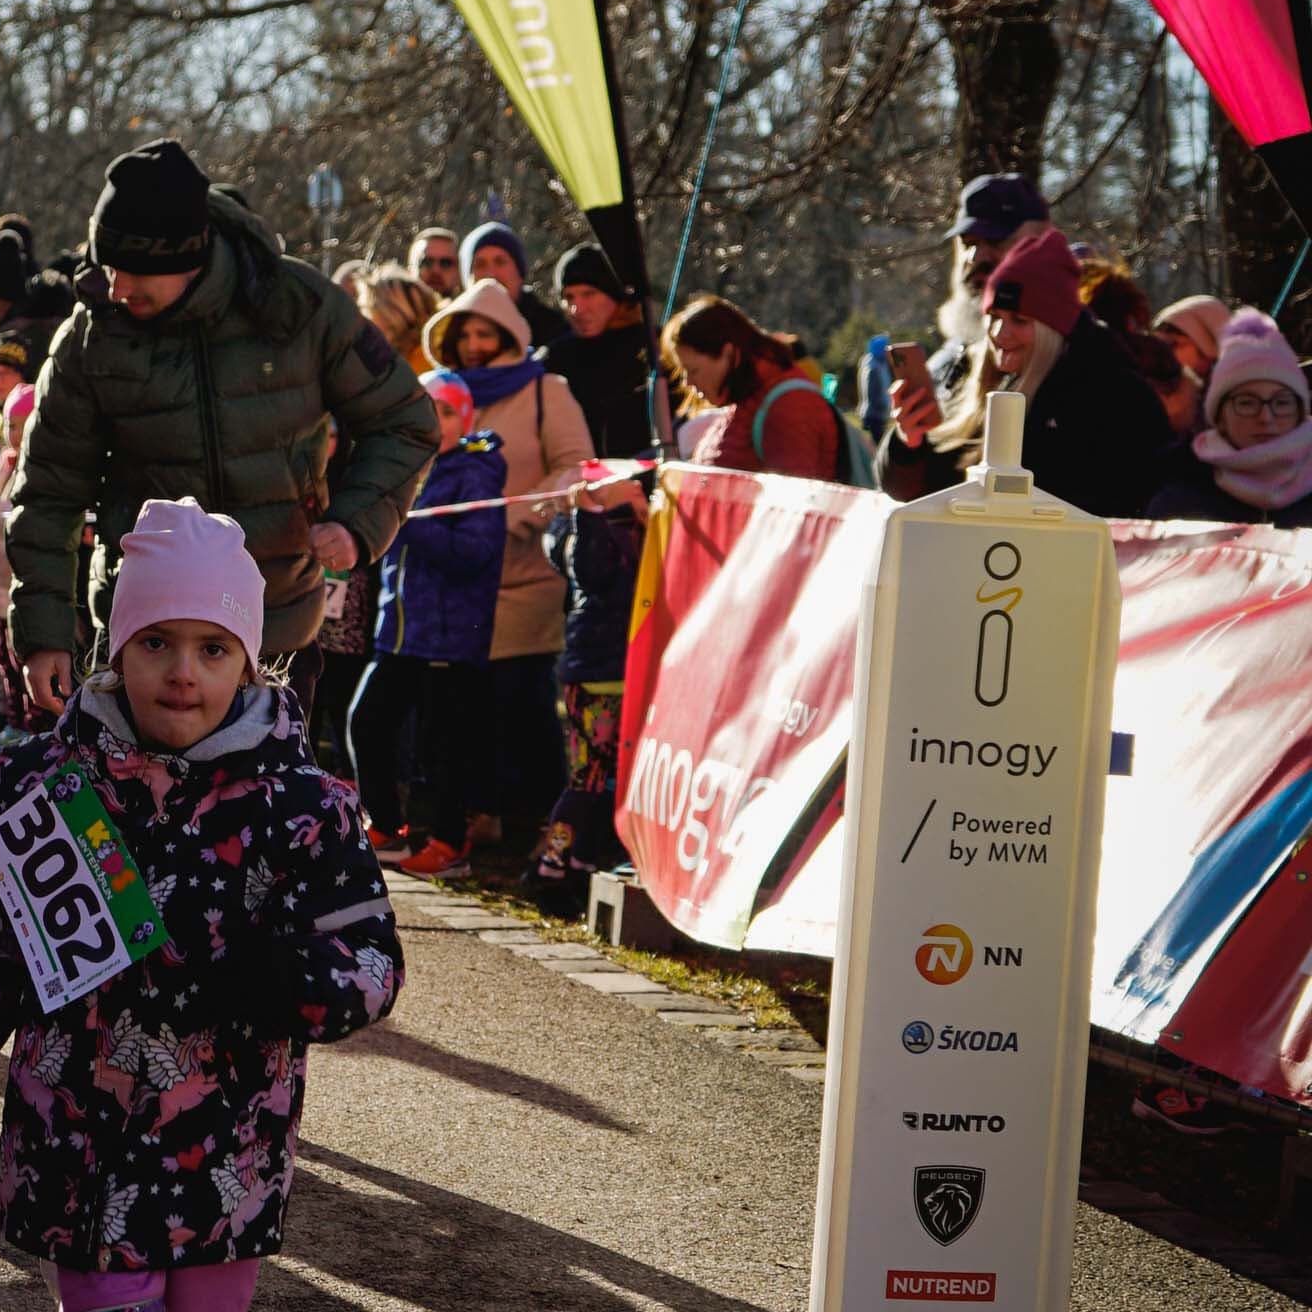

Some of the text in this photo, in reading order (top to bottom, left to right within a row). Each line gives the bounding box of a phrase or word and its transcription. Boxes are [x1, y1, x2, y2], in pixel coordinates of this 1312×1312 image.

[910, 728, 1058, 777] innogy
[952, 812, 1052, 836] Powered
[949, 839, 1048, 866] by MVM
[984, 946, 1023, 967] NN
[937, 1025, 1019, 1052] ŠKODA
[922, 1112, 1006, 1133] RUNTO
[920, 1172, 979, 1183] PEUGEOT
[893, 1277, 991, 1296] NUTREND
